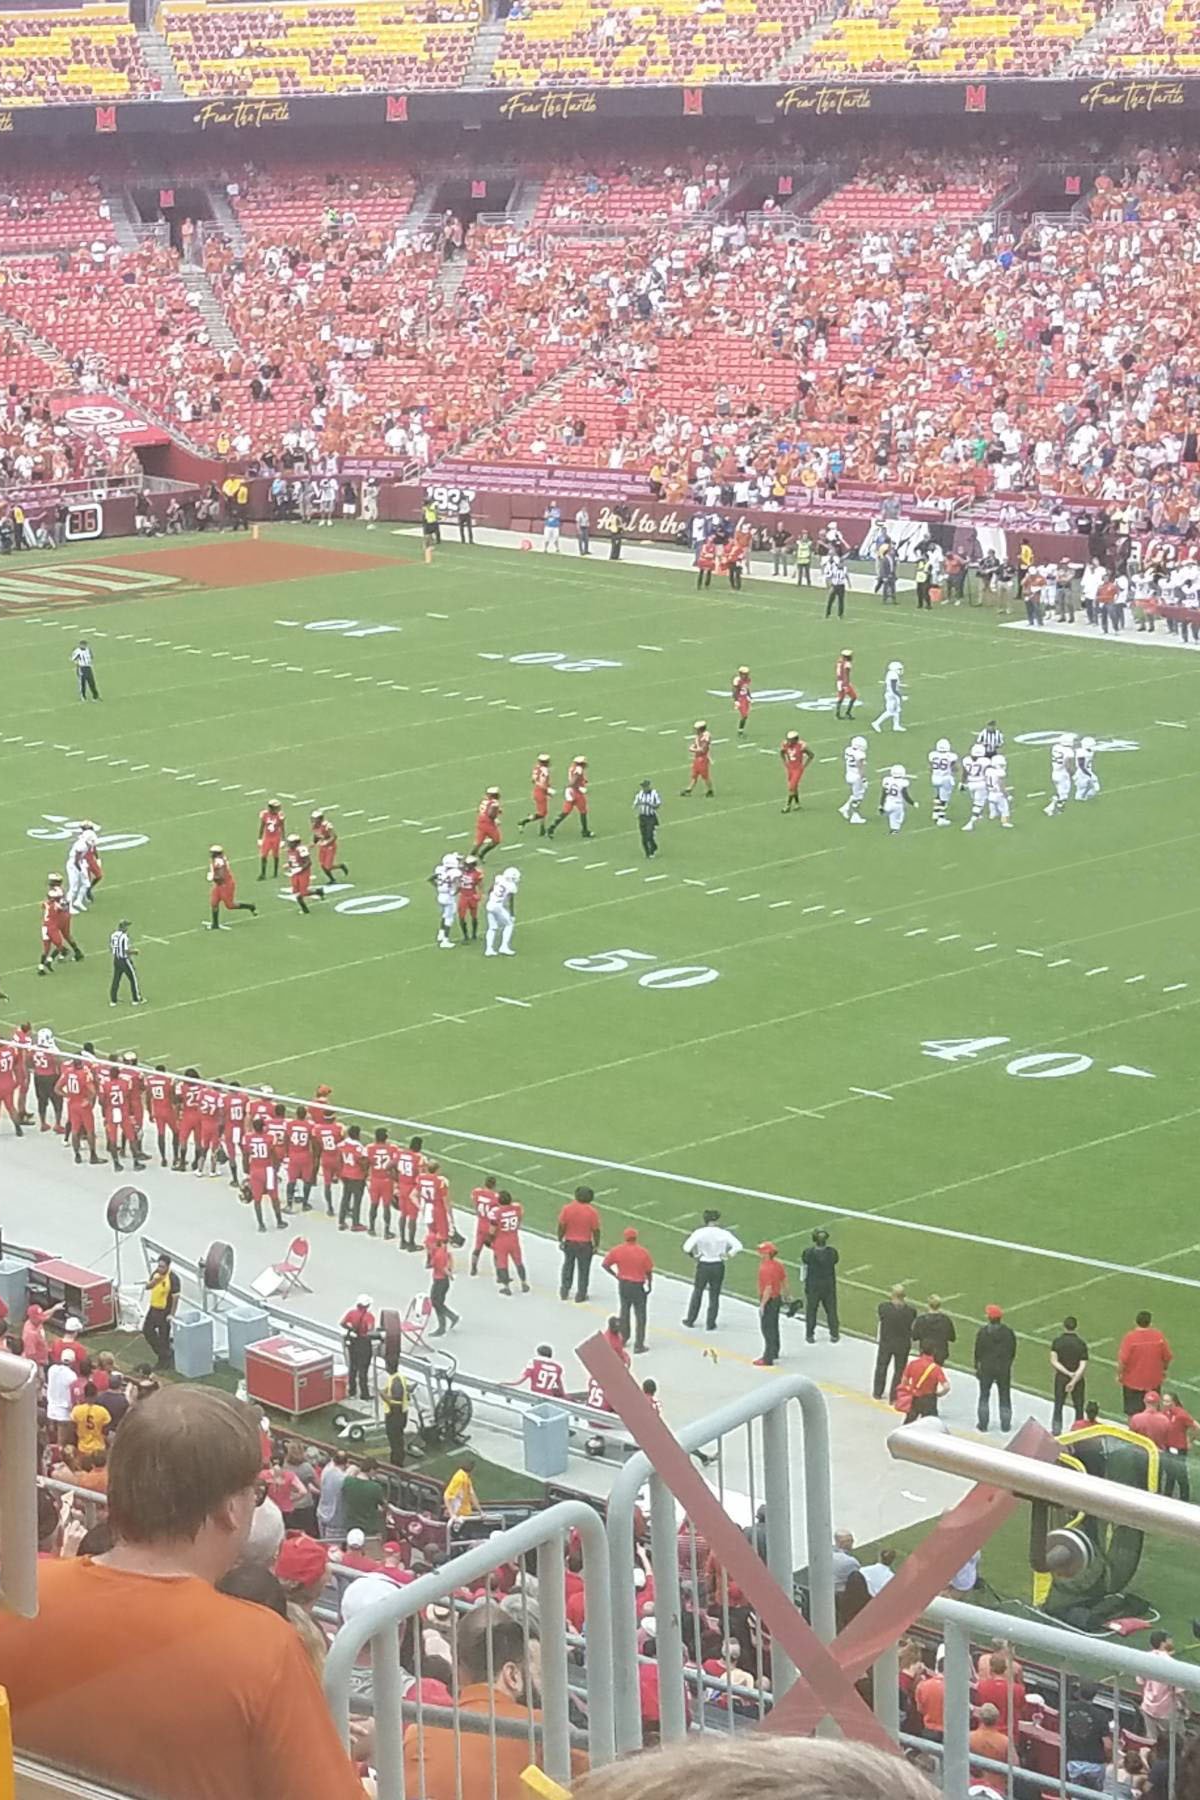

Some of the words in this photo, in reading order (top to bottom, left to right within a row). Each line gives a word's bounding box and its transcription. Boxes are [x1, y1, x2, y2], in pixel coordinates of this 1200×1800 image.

[73, 510, 95, 533] 36
[638, 514, 657, 533] to
[563, 948, 720, 990] 50
[919, 1036, 1094, 1079] 40
[249, 1142, 268, 1158] 30
